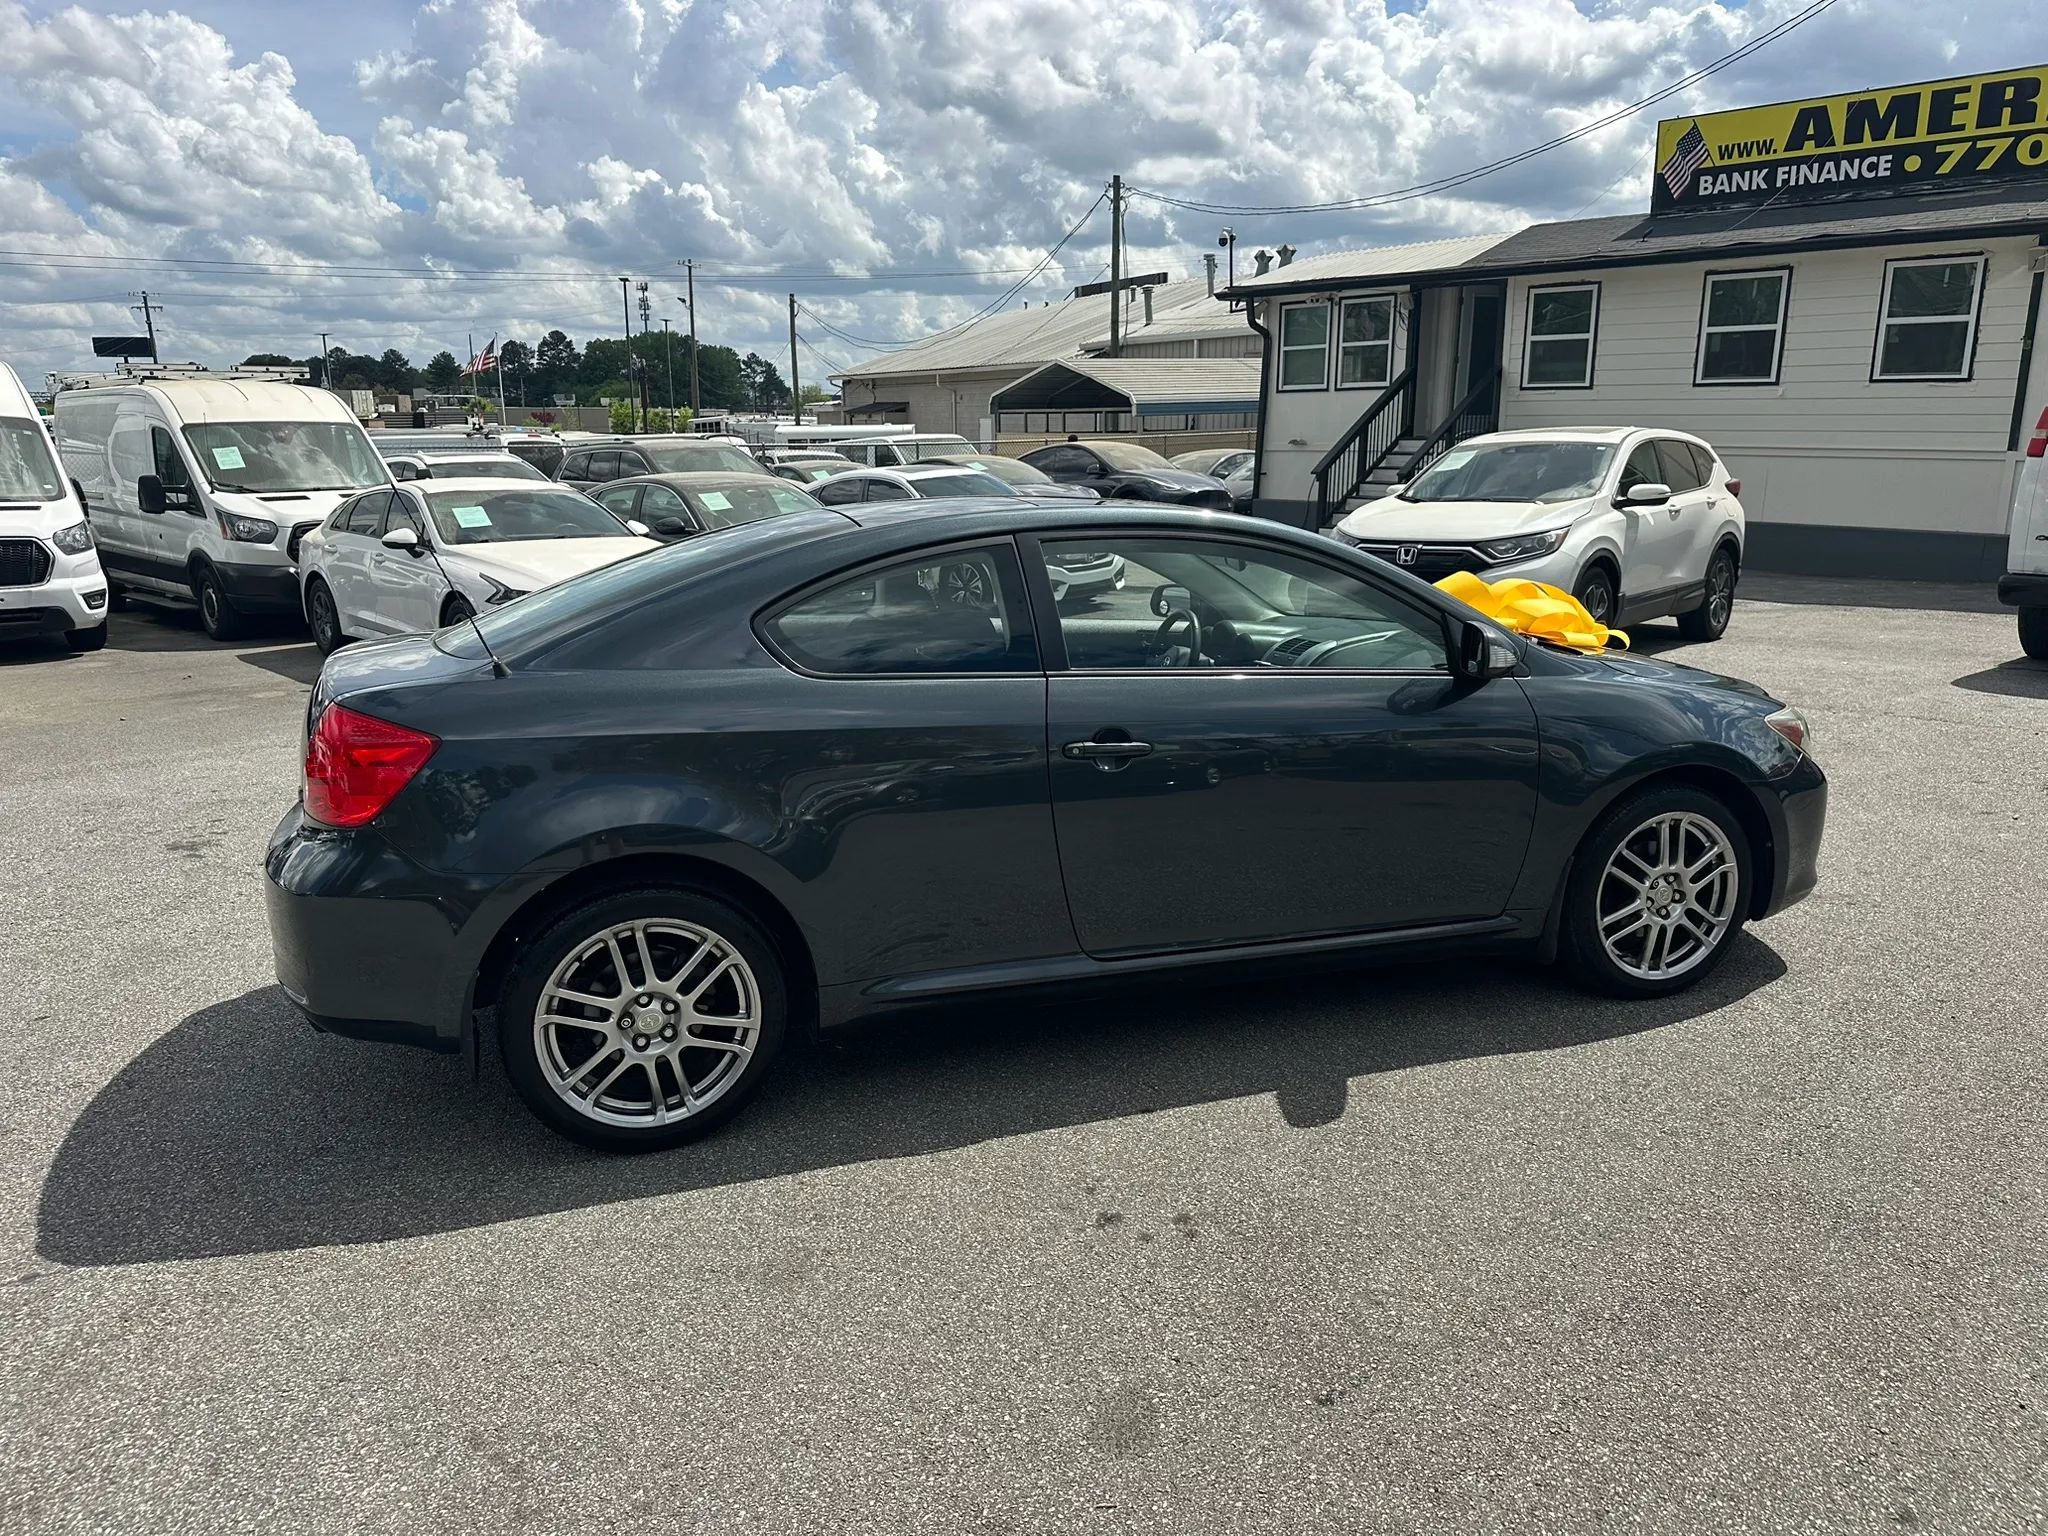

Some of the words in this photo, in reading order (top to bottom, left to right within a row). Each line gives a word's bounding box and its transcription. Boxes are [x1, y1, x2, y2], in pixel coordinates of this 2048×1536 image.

[1783, 76, 2048, 153] AMER
[1698, 168, 1769, 196] BANK
[1775, 154, 1893, 188] FINANCE
